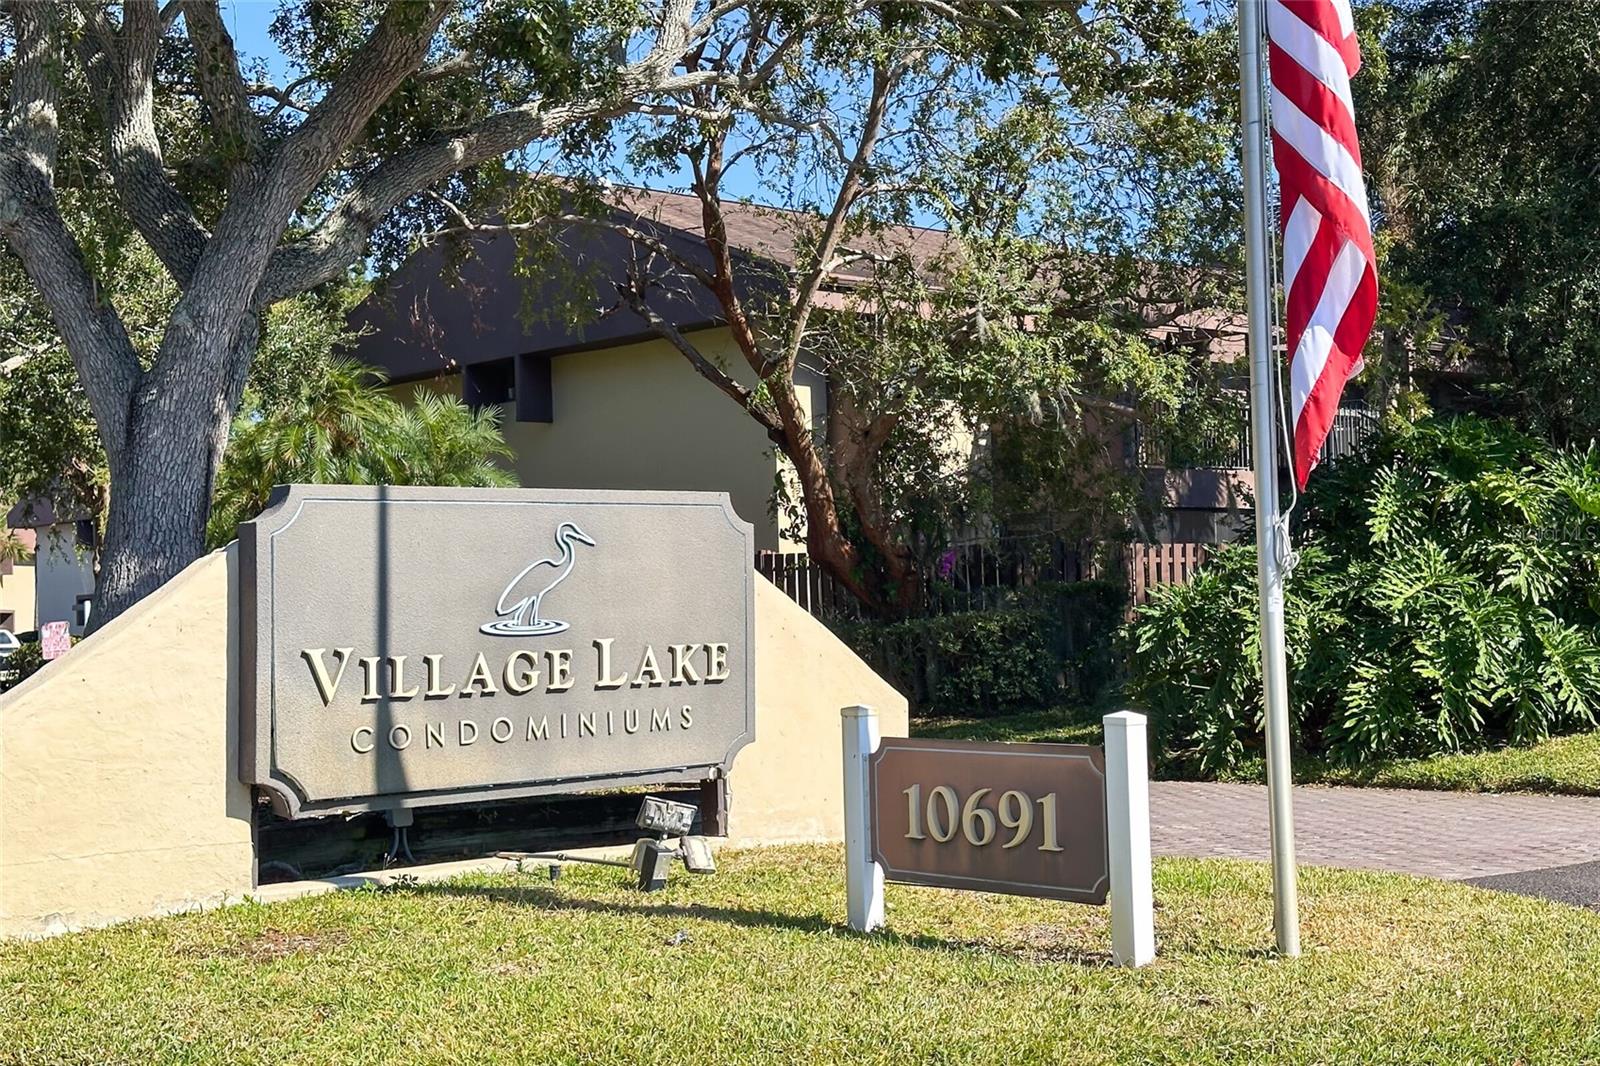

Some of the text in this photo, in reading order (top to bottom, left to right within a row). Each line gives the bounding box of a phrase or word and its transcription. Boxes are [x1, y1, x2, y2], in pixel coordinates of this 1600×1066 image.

[301, 638, 730, 707] VILLAGE LAKE
[351, 705, 693, 754] CONDOMINIUMS
[902, 784, 1064, 852] 10691
